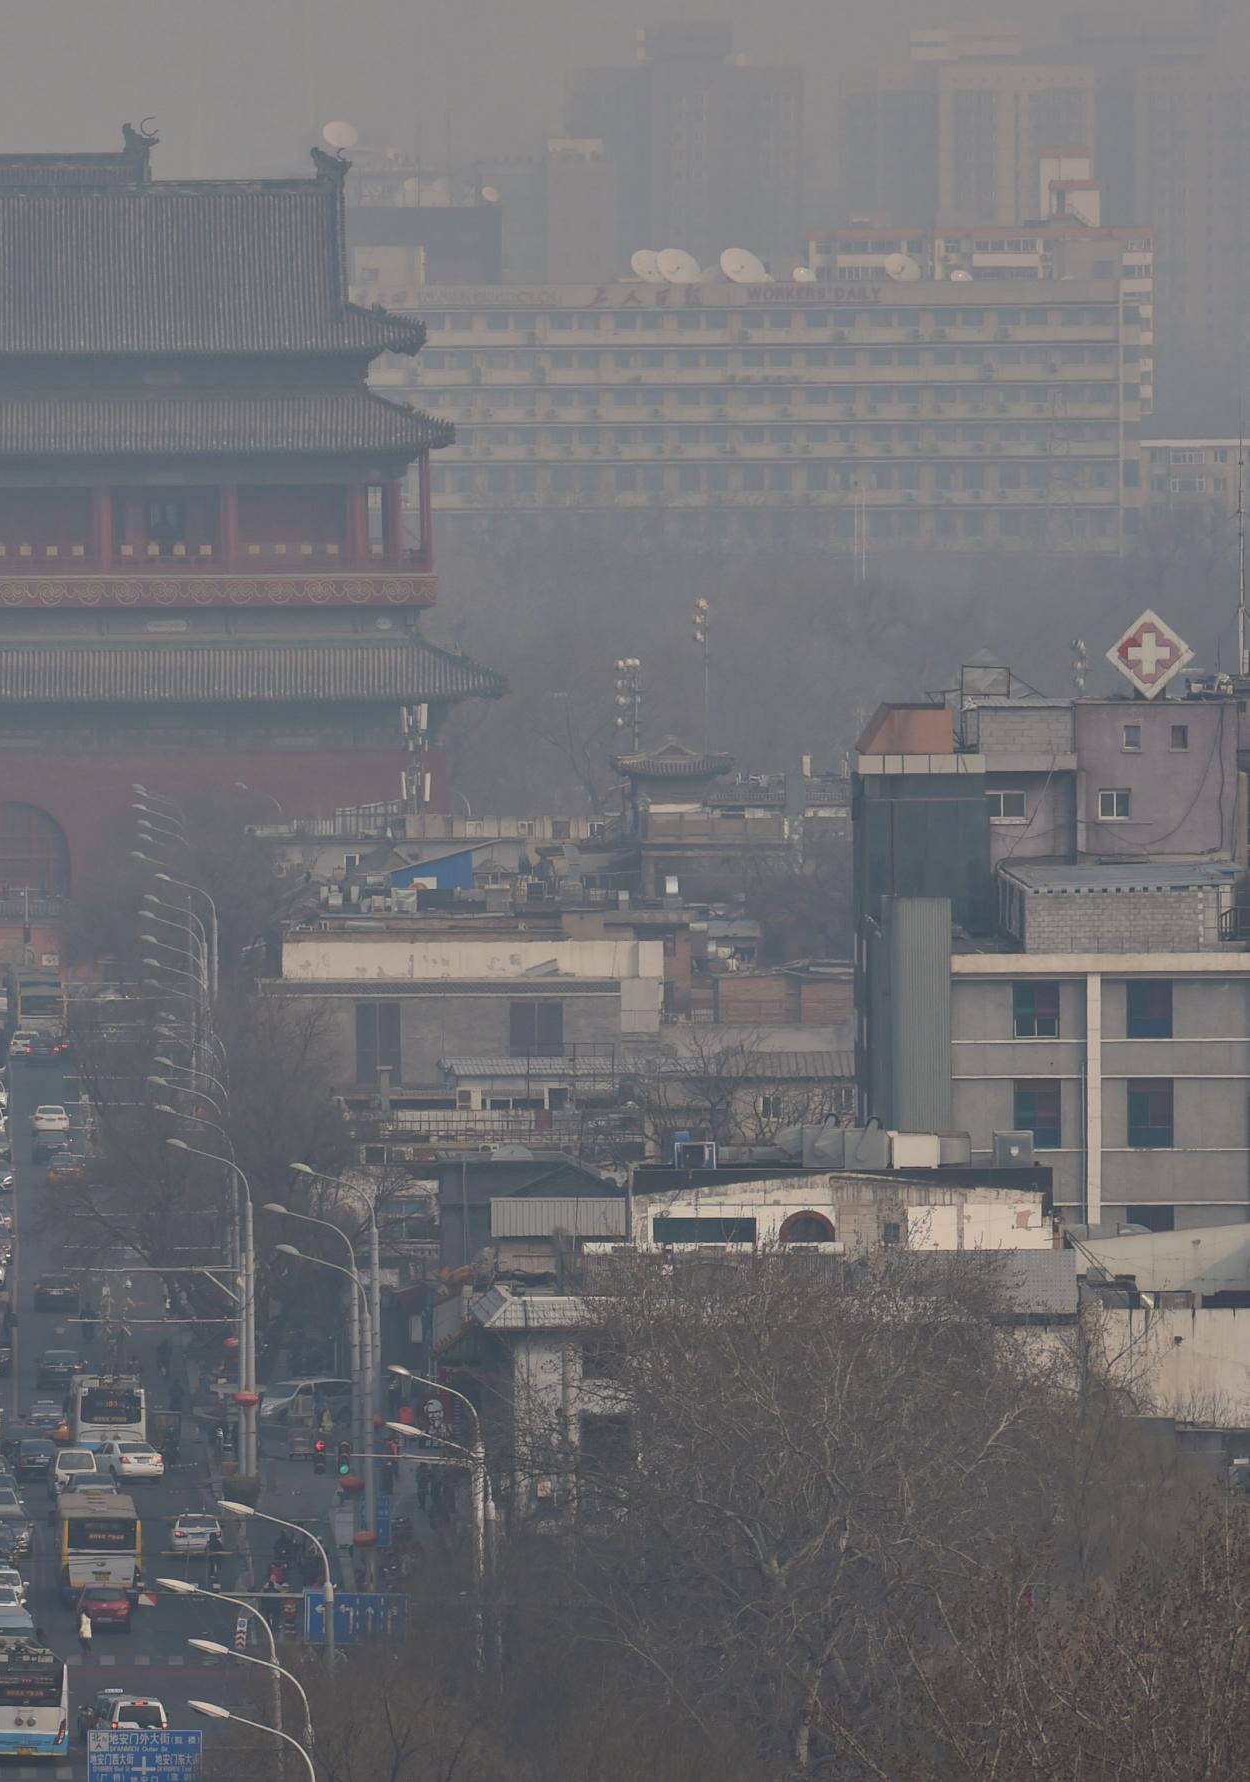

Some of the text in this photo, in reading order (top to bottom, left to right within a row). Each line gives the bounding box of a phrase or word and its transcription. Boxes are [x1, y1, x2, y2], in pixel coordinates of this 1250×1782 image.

[835, 287, 881, 300] DAILY
[110, 1733, 170, 1745] 地安门外大街
[90, 1753, 134, 1765] 地安门西大街
